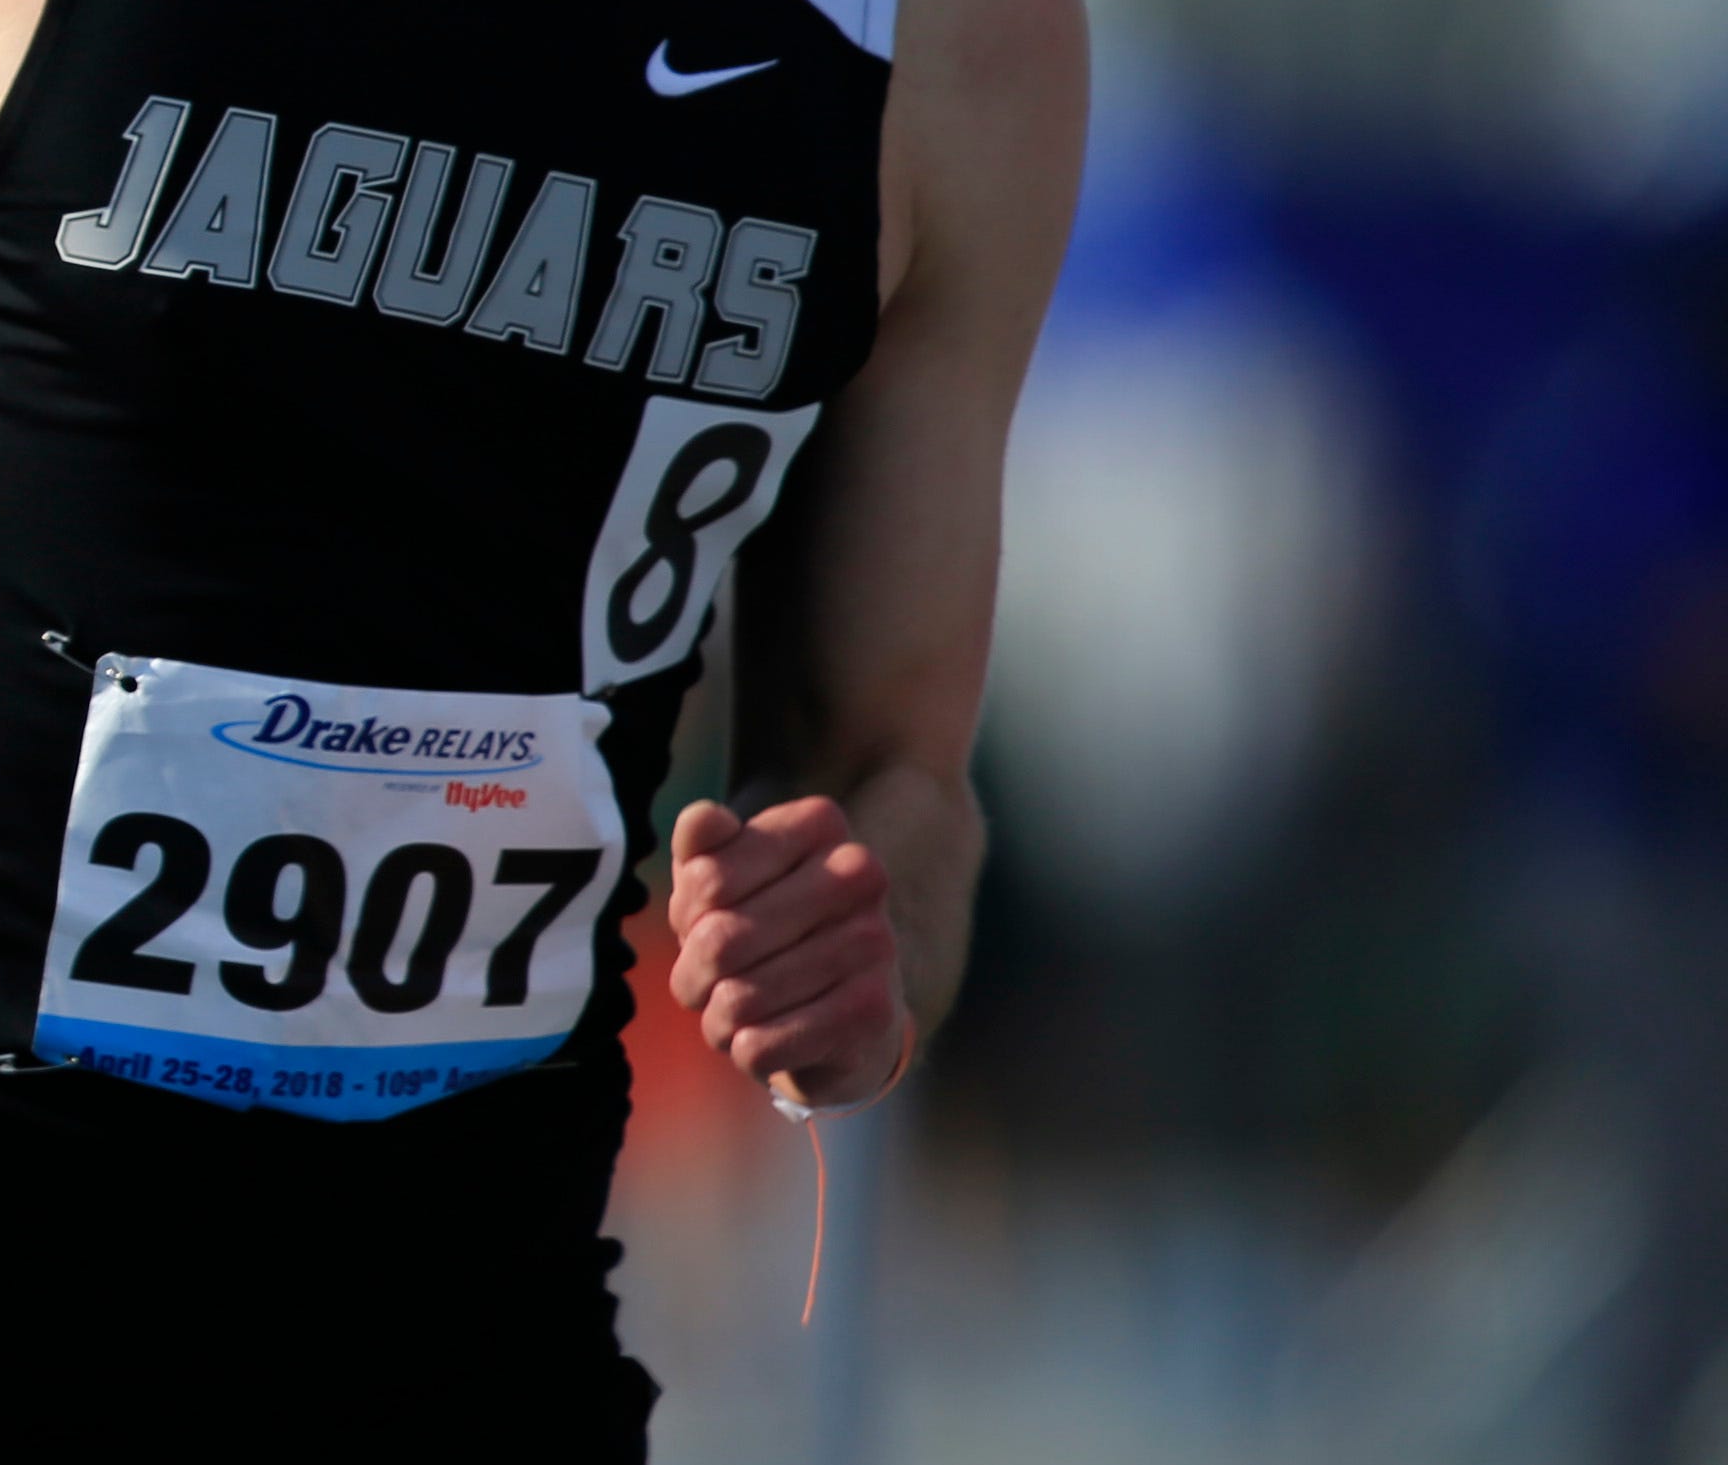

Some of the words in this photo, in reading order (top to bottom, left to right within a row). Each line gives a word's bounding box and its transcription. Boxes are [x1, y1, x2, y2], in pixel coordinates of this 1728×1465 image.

[56, 96, 817, 400] JAGUARS
[606, 421, 773, 663] 8
[252, 694, 411, 755] Drake
[412, 729, 536, 761] RELAYS
[69, 811, 605, 1014] 2907
[161, 1058, 260, 1098] 25-28,
[270, 1070, 345, 1098] 2018
